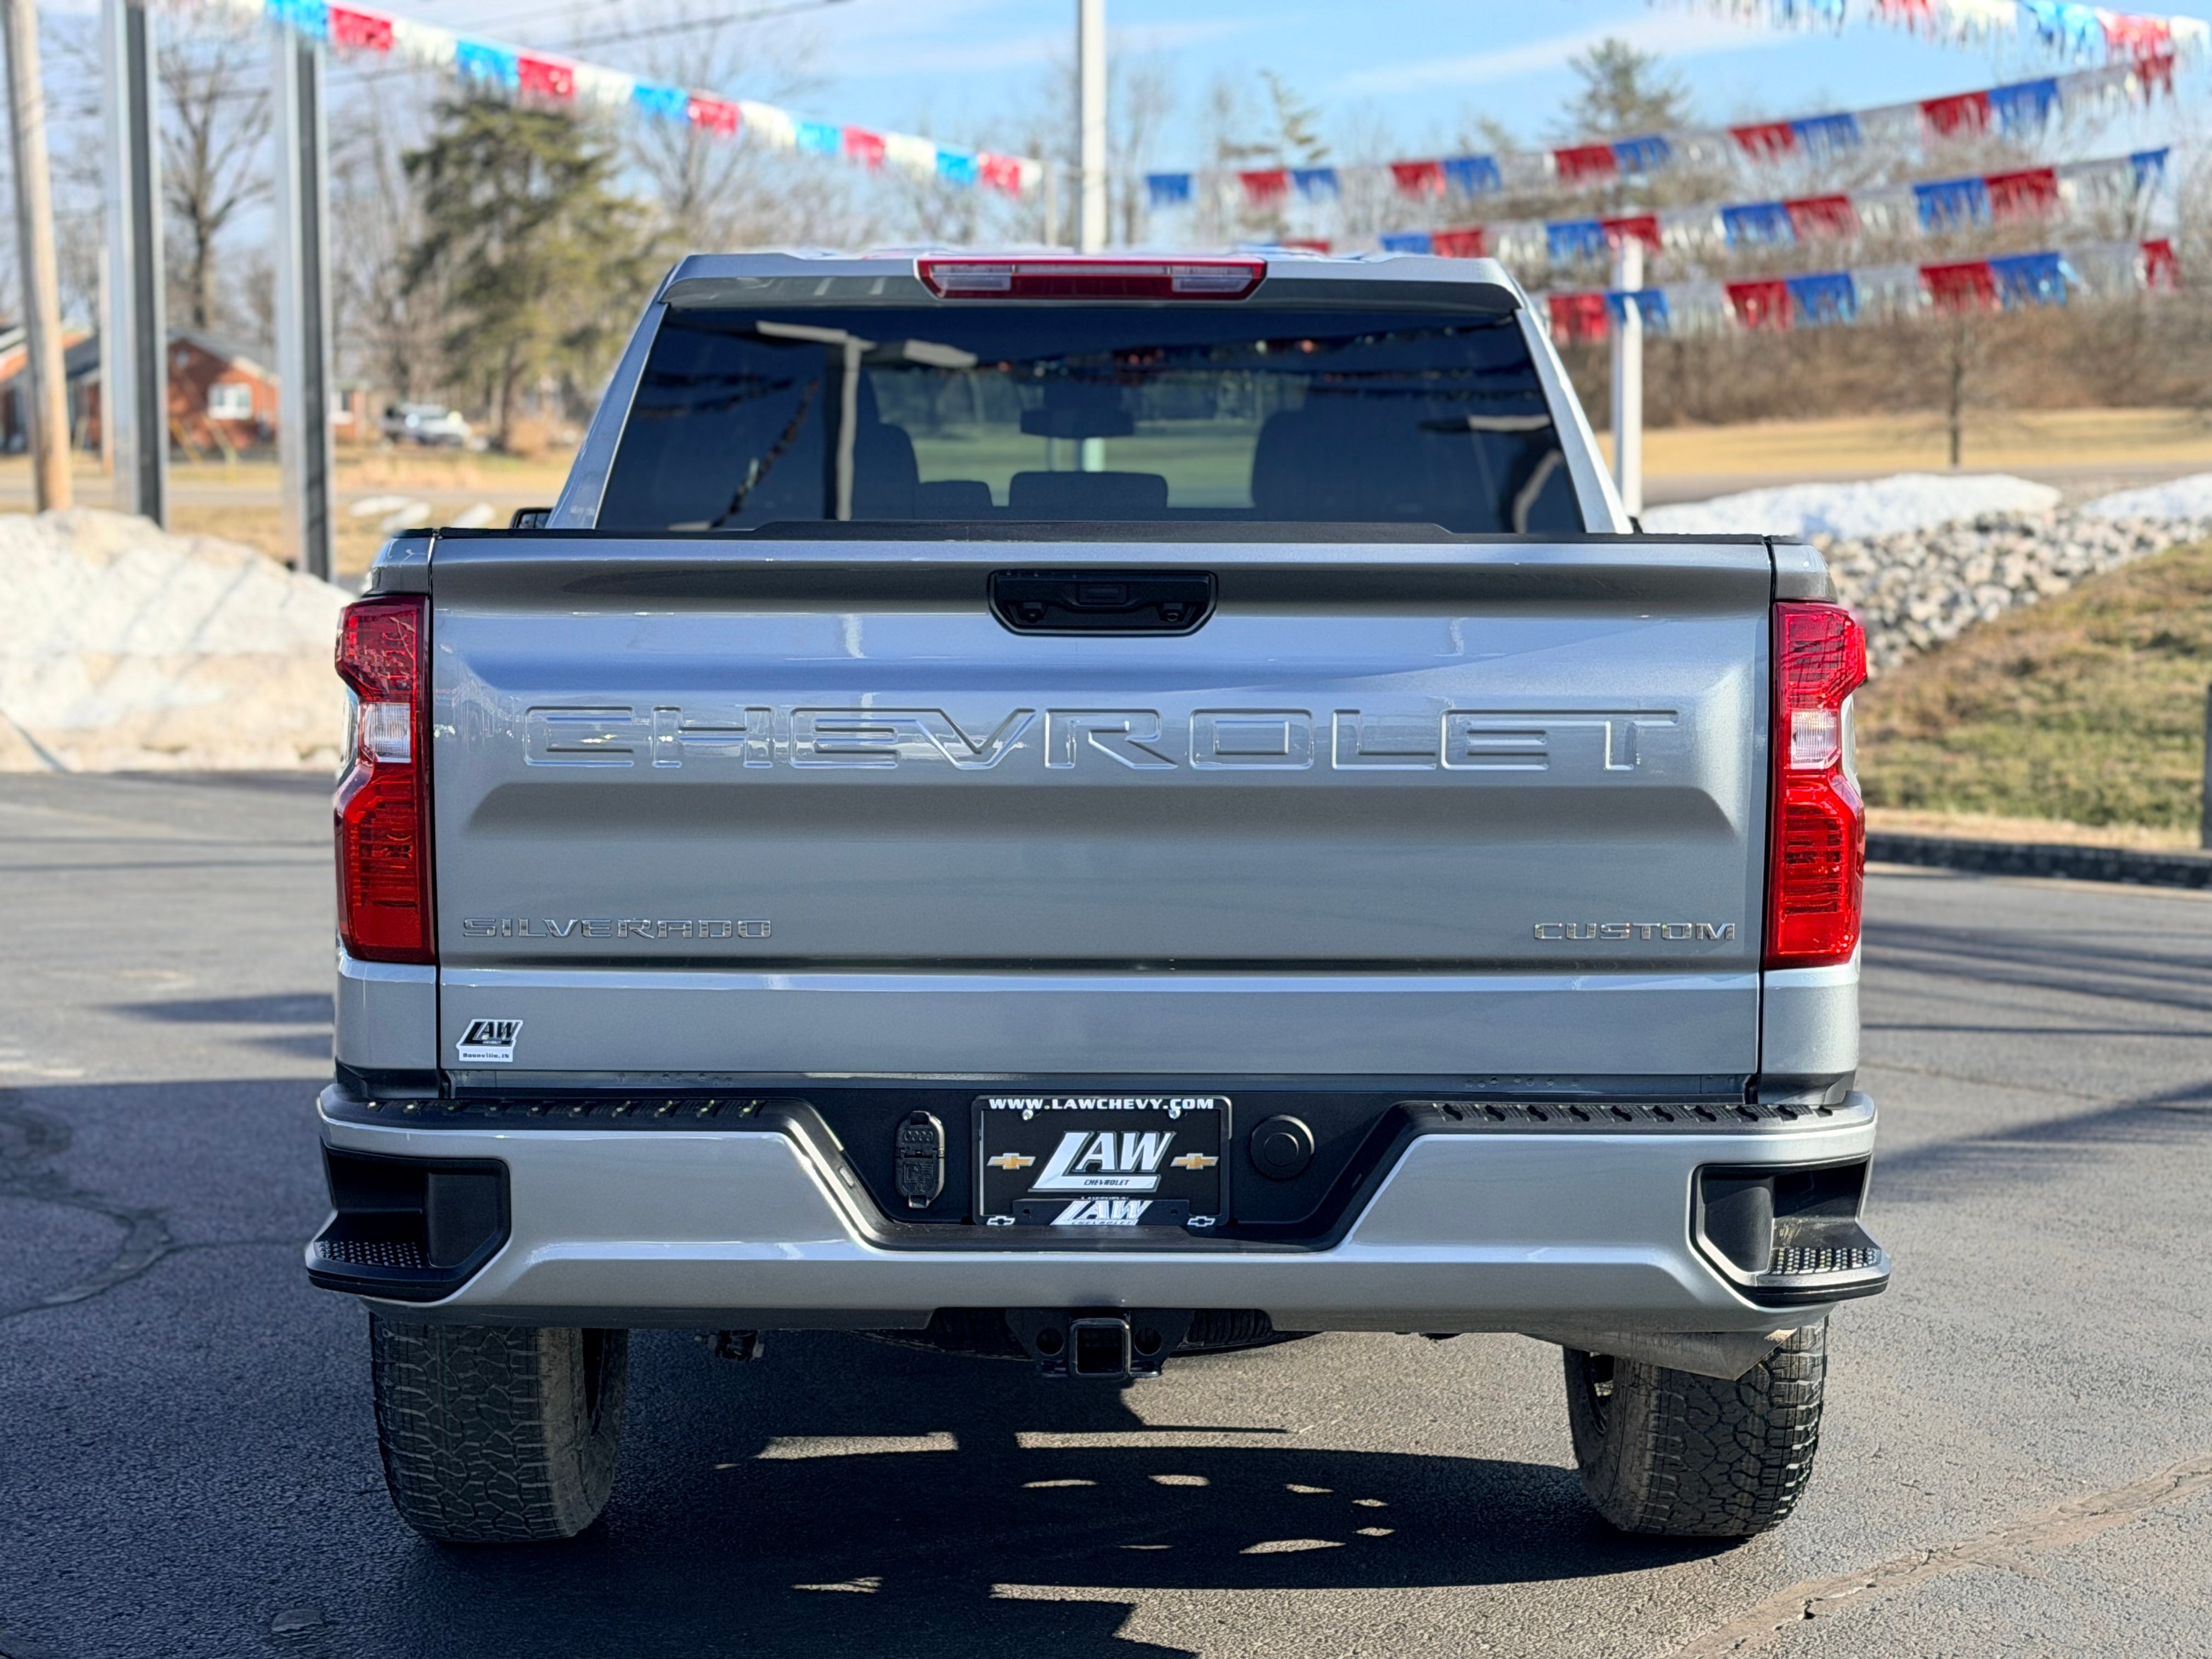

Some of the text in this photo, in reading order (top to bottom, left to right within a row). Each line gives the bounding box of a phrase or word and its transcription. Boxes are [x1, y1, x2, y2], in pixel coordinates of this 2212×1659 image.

[523, 707, 1678, 770] CHEVROLET
[463, 918, 771, 939] SILVERADO
[1534, 922, 1735, 940] CUSTOM
[461, 1021, 521, 1045] LAW
[989, 1098, 1214, 1110] WWW.LAWCHEVY.COM
[1029, 1131, 1176, 1192] LAW
[1049, 1200, 1154, 1226] LAW
